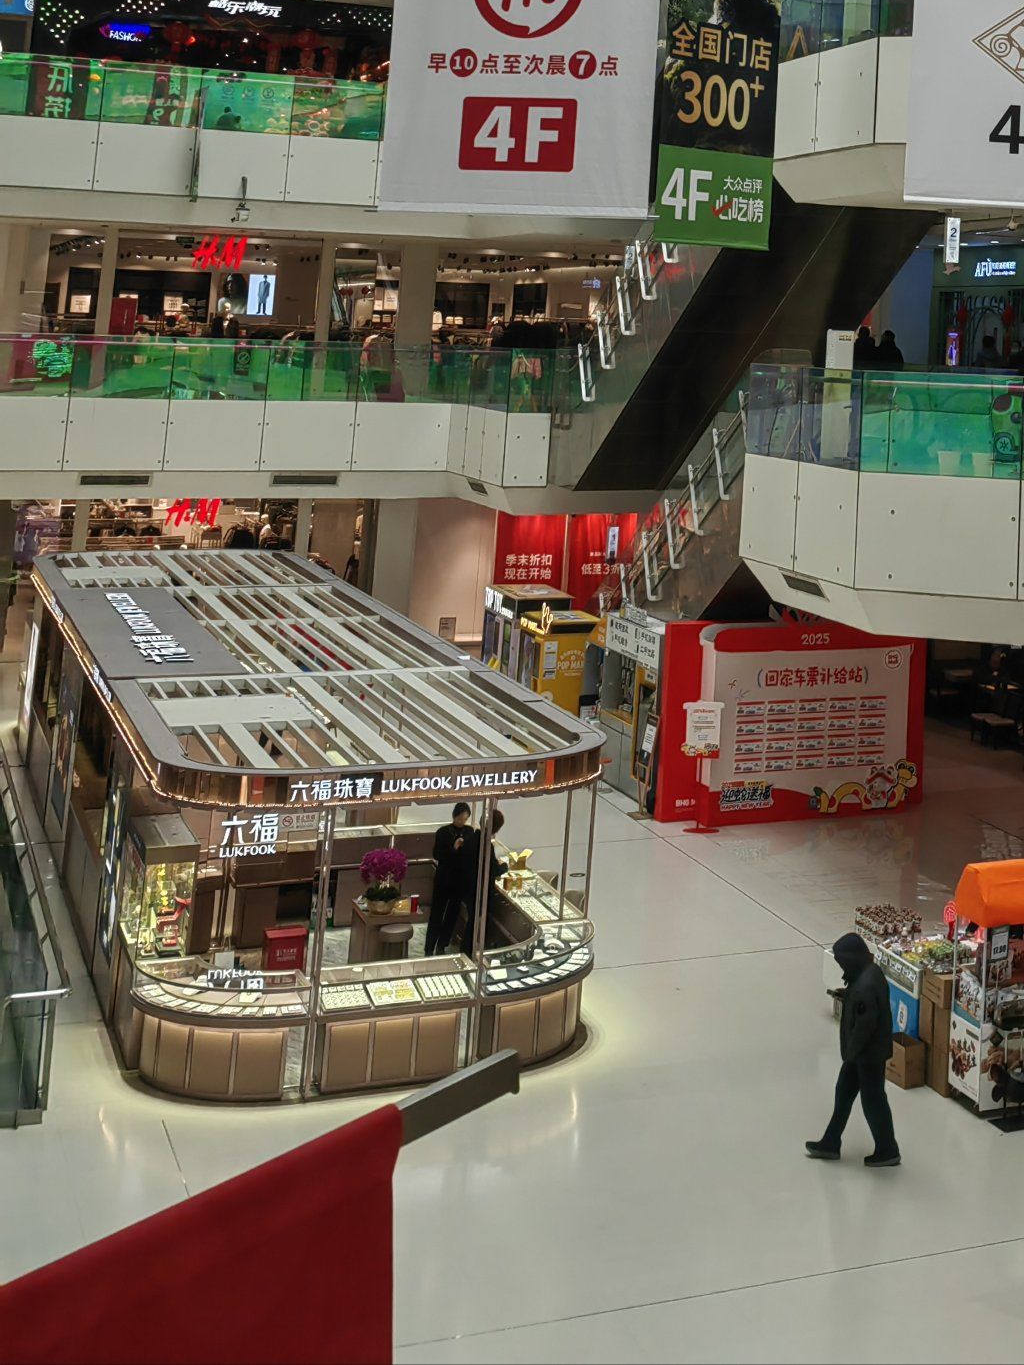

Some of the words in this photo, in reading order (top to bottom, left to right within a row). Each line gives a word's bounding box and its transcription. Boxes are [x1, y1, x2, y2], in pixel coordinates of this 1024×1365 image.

[672, 25, 773, 73] 全国门店
[473, 104, 564, 164] 4F
[660, 166, 711, 221] 4F
[722, 174, 764, 195] 大众点评
[950, 227, 957, 238] 2
[192, 235, 248, 271] H&M
[801, 633, 830, 646] 2025
[290, 777, 375, 803] 六福珠寶
[381, 774, 452, 794] LUKFOOK
[455, 769, 538, 791] JEWELLERY
[220, 812, 279, 847] 六福
[218, 842, 277, 859] LUKFOOK
